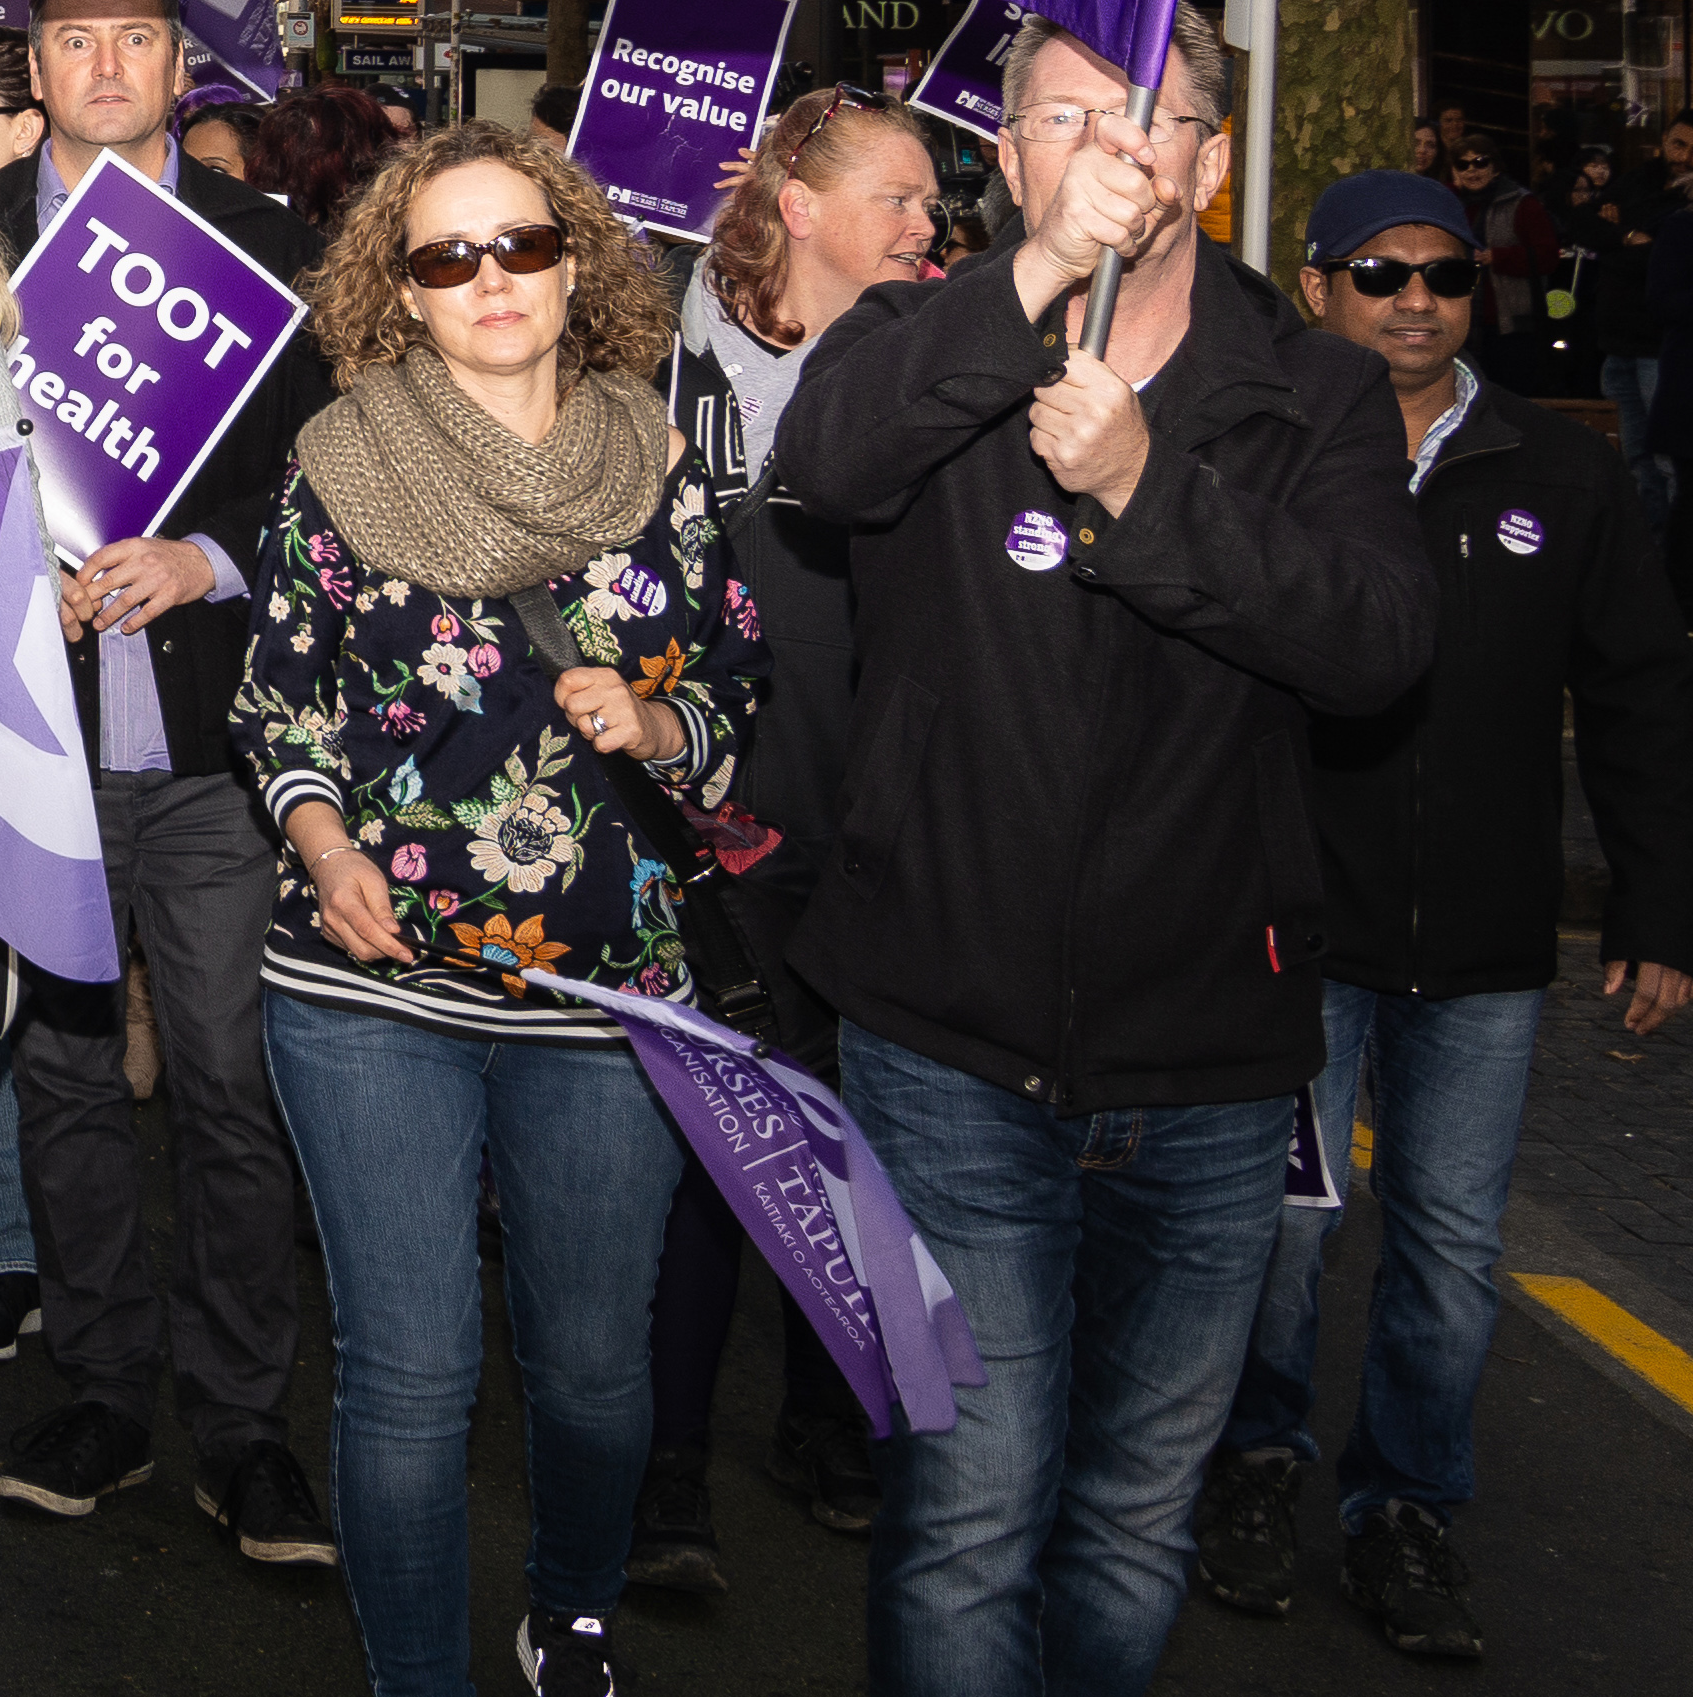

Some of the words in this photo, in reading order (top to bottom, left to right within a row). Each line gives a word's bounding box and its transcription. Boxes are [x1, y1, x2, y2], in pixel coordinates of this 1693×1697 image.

[353, 55, 384, 65] SAIL
[388, 55, 411, 65] AW
[612, 36, 757, 97] Recognise
[600, 73, 656, 107] our
[661, 91, 749, 133] value
[76, 217, 252, 371] TOOT
[72, 315, 162, 395] for
[8, 335, 162, 483] health
[1013, 525, 1062, 543] standing
[1018, 540, 1053, 554] strong
[752, 1181, 796, 1249] KAITIAKI
[793, 1250, 805, 1263] O
[802, 1267, 864, 1351] AOTEAROA
